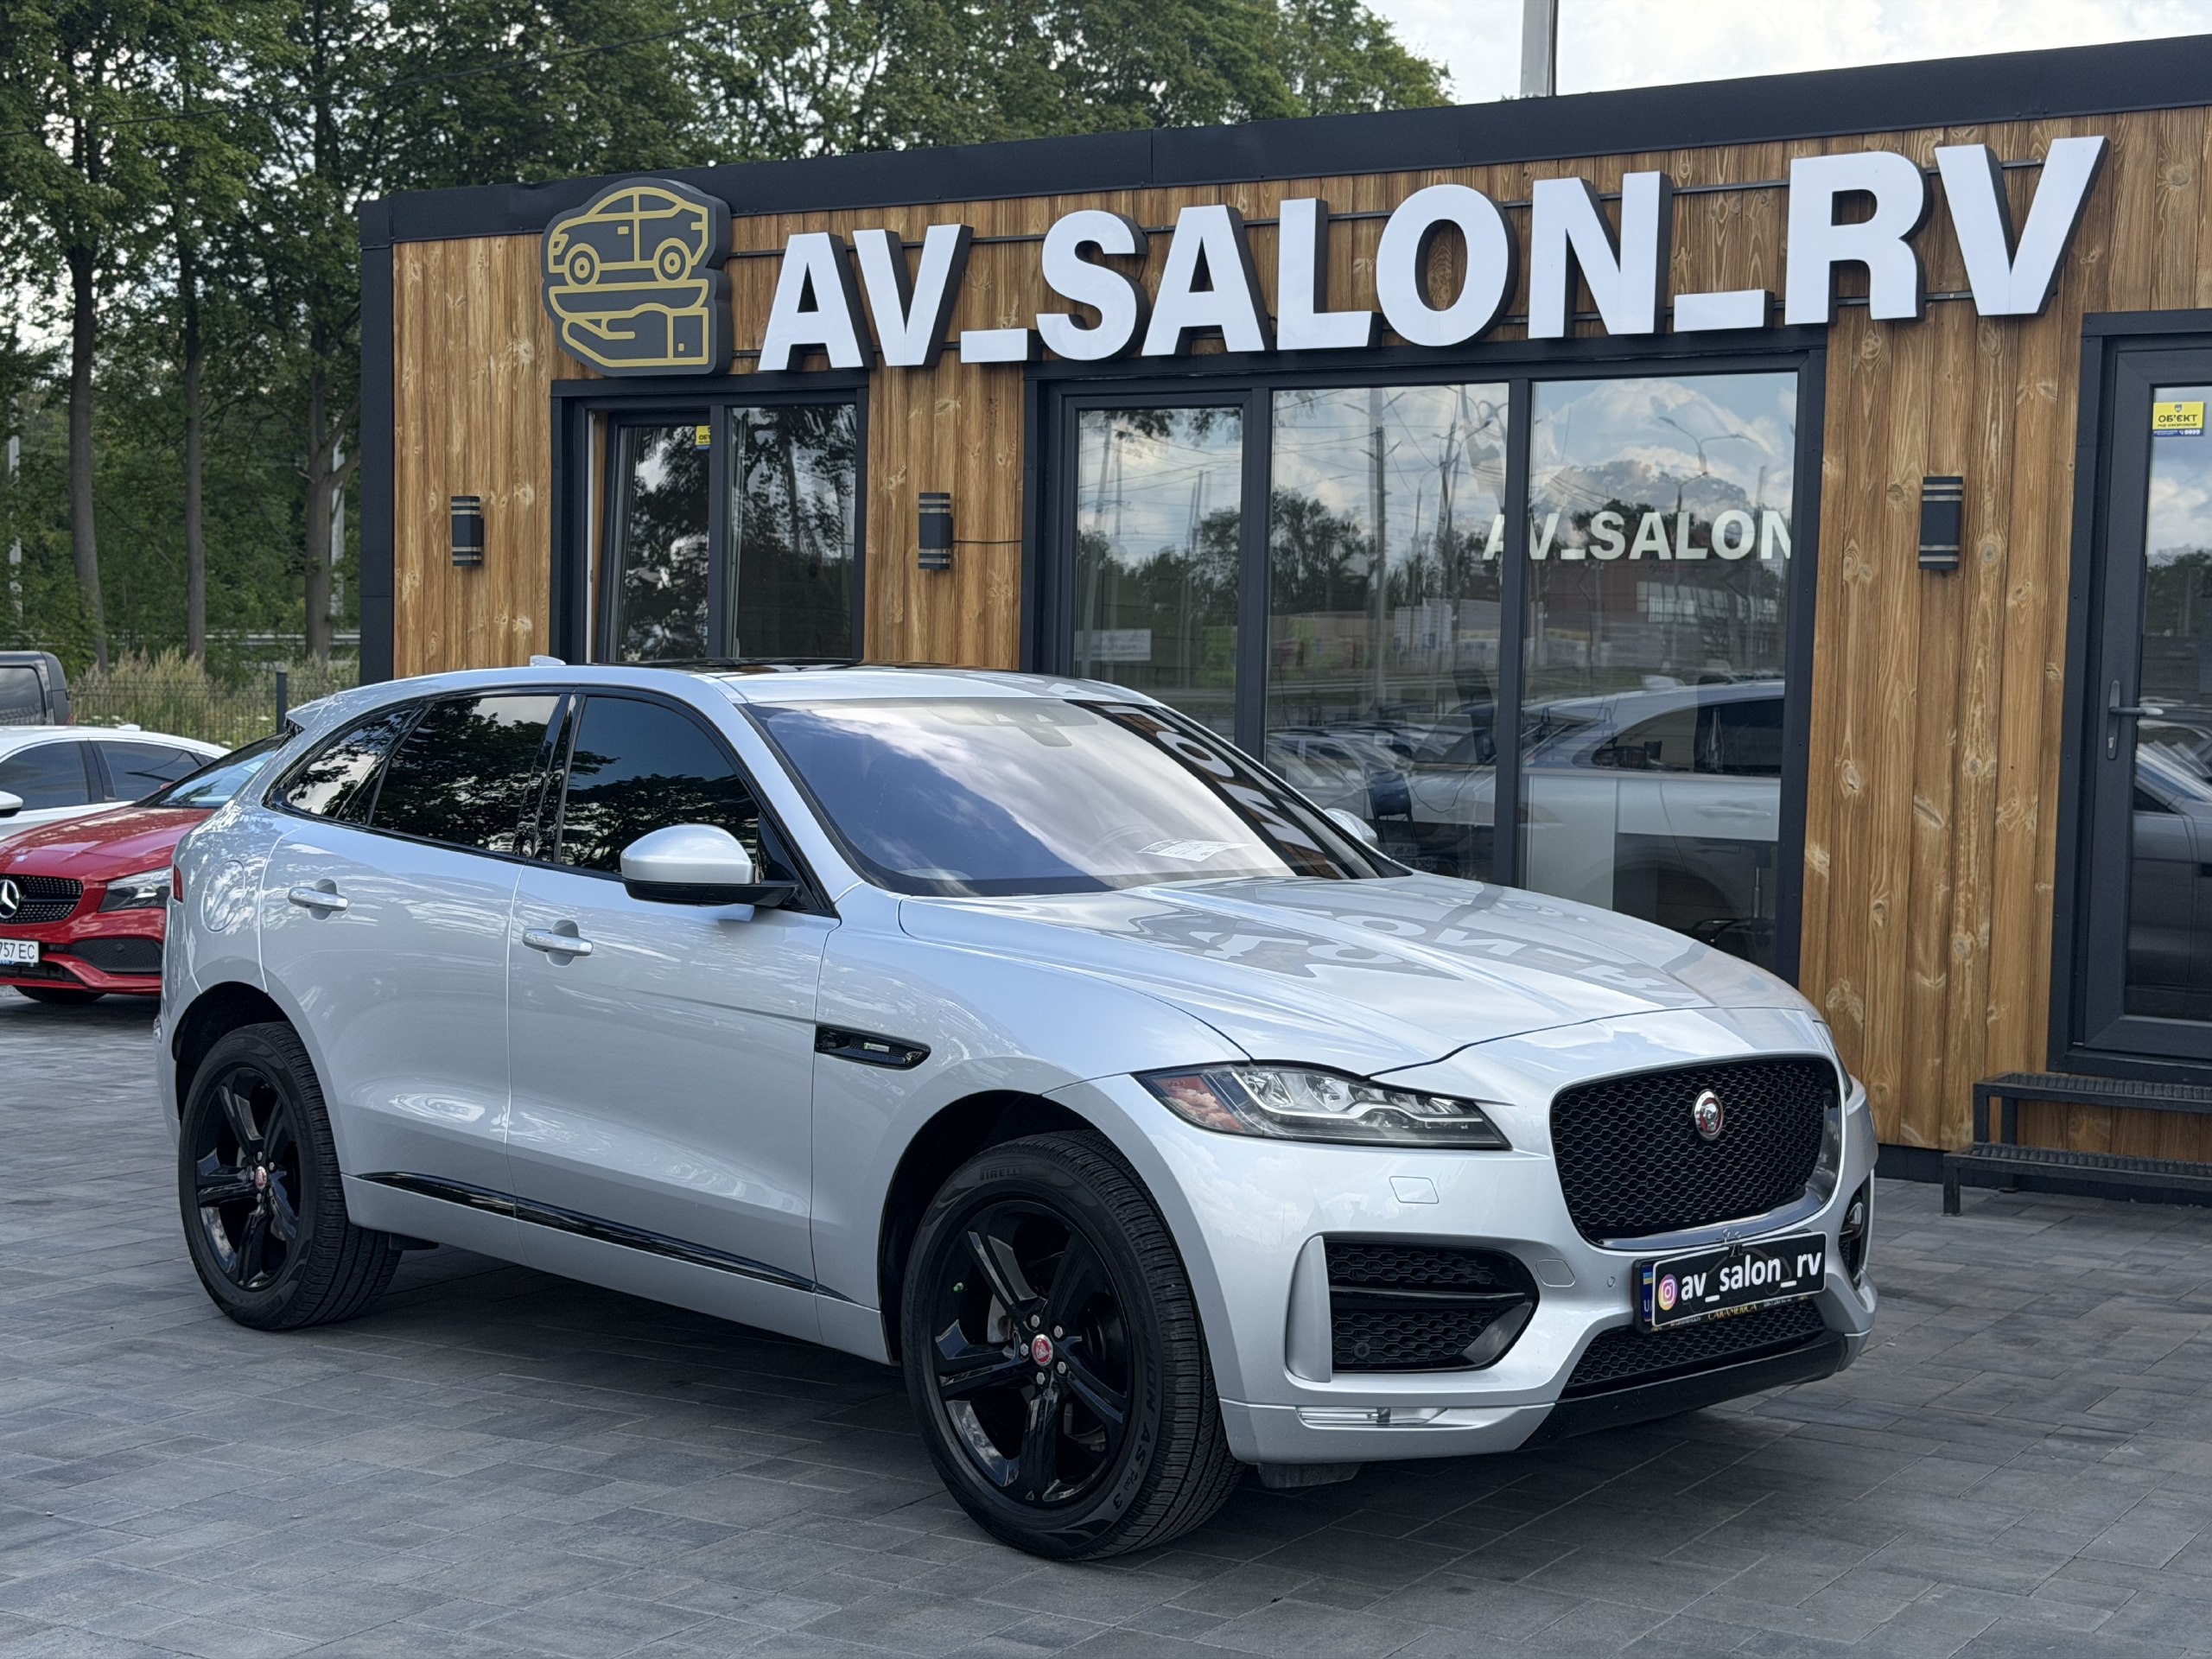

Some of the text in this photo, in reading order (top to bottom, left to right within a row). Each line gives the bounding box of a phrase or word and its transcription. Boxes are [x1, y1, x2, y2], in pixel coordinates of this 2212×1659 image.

[759, 136, 2108, 372] AV_SALON_RV
[18, 944, 35, 959] EC
[980, 1166, 1023, 1181] PIRELLI
[1681, 1252, 1822, 1303] av_salon_rv
